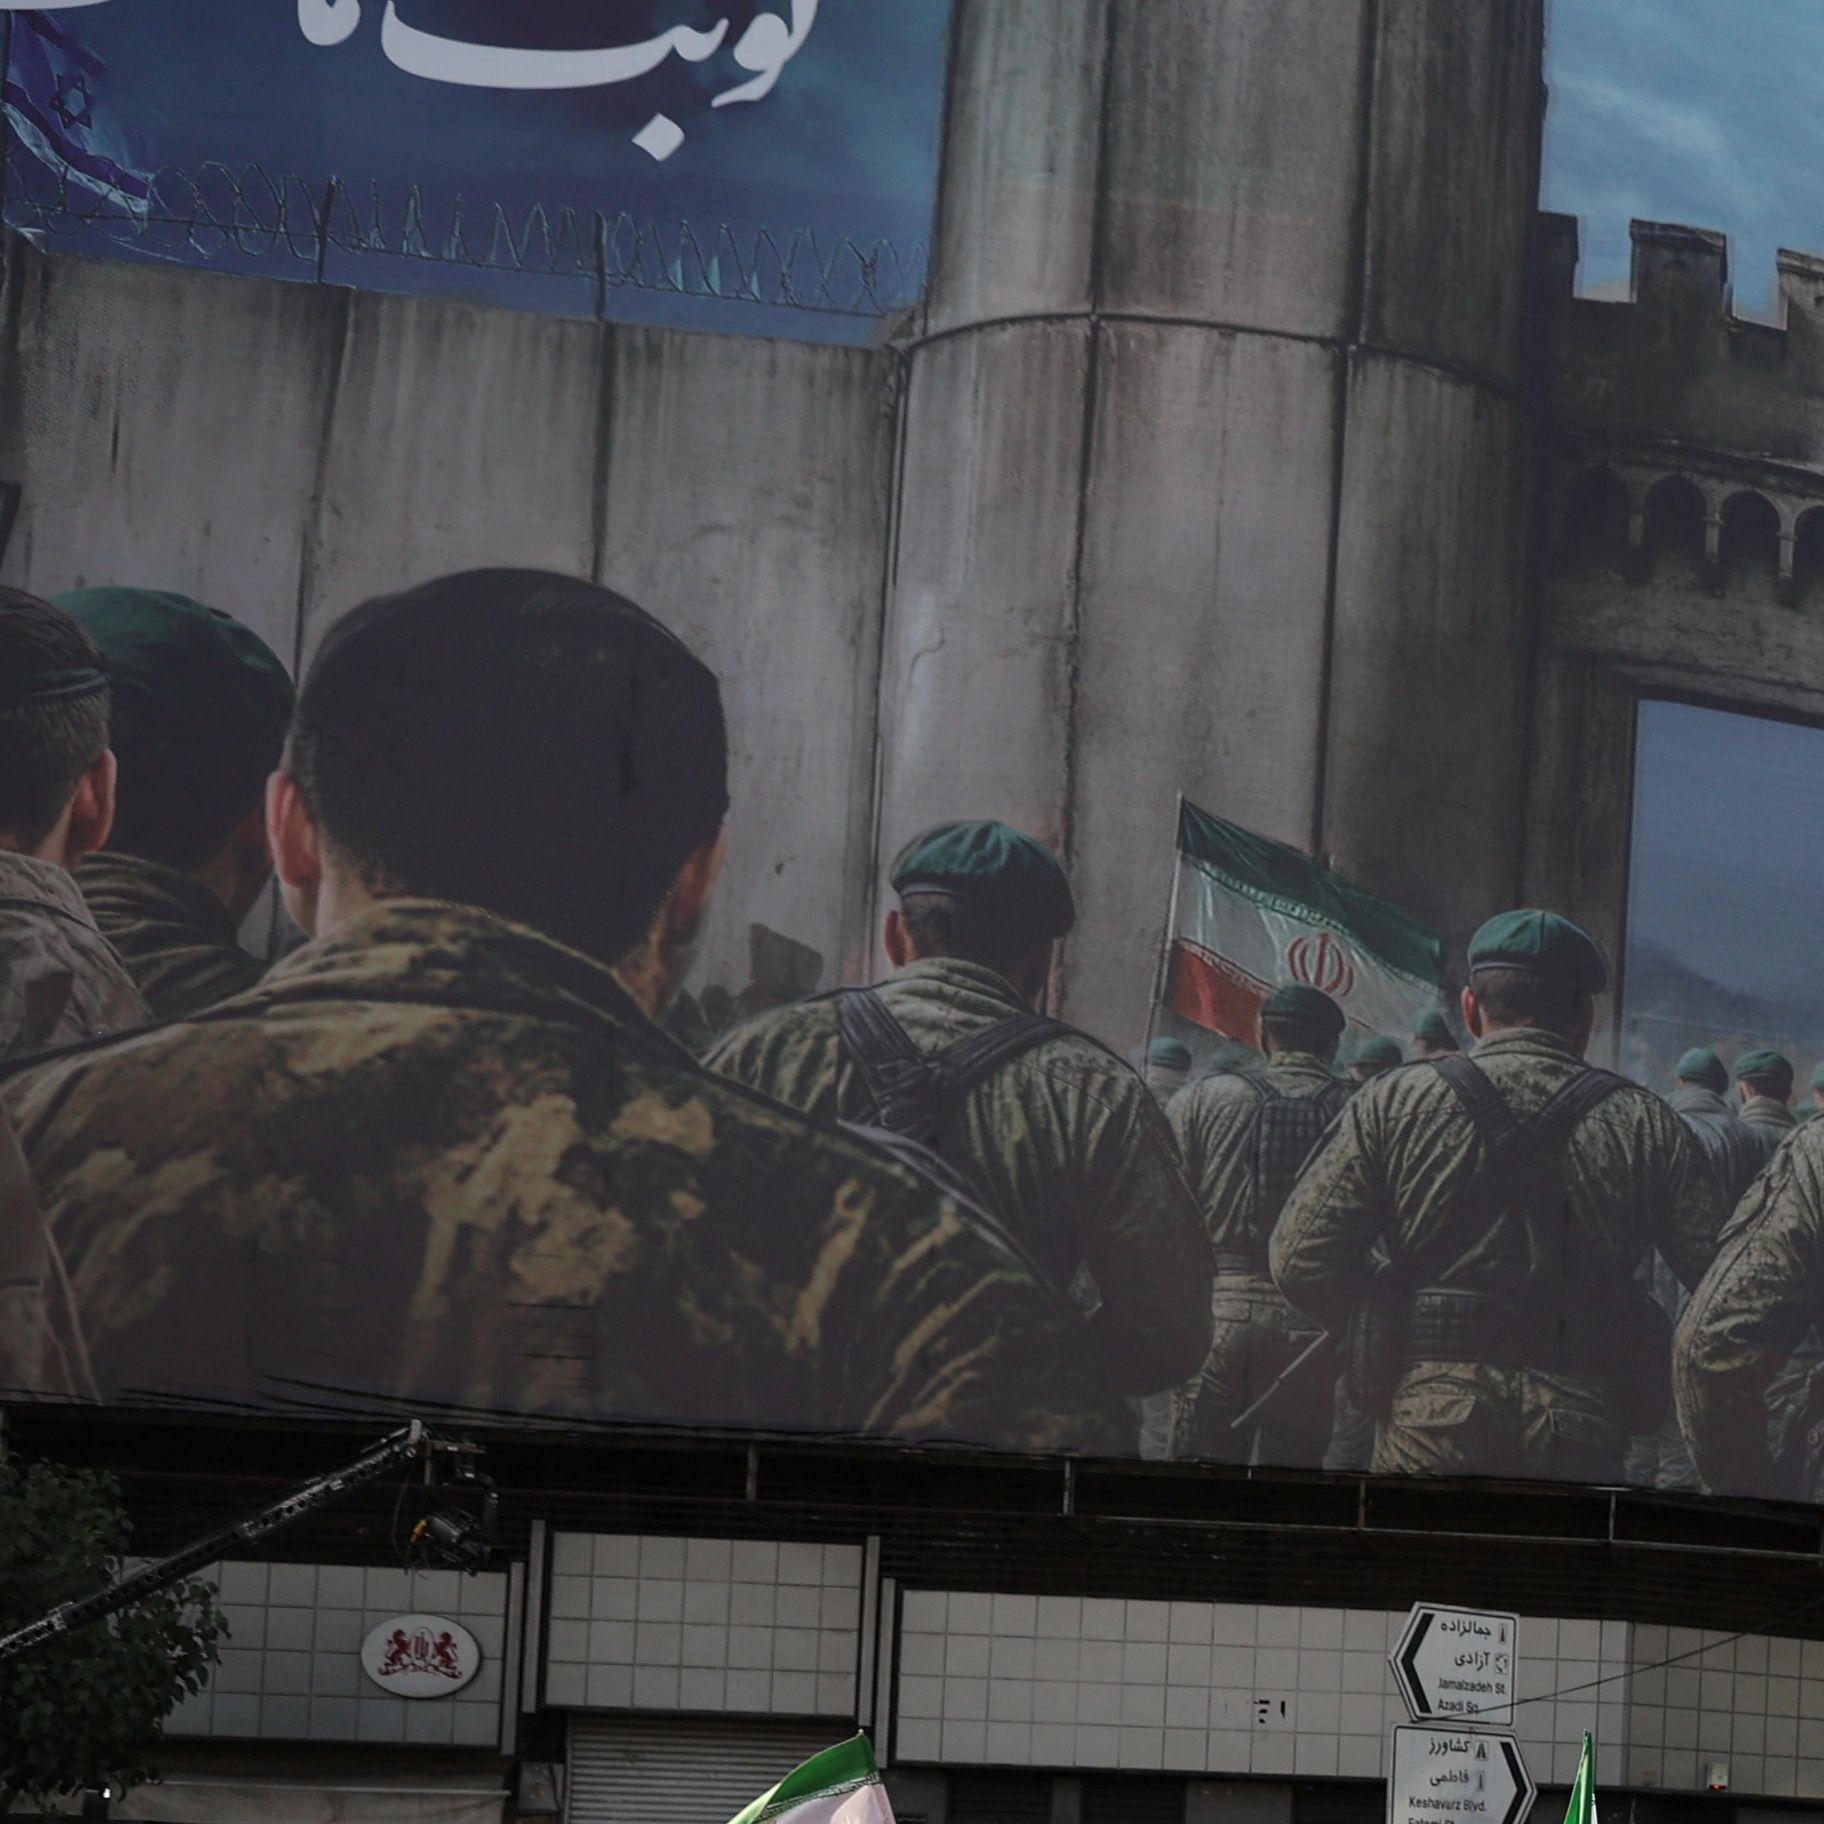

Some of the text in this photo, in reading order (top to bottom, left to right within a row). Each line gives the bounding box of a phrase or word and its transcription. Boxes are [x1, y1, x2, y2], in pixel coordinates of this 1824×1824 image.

[1440, 1619, 1492, 1641] جمالزاده
[1454, 1651, 1490, 1673] آزادی
[1437, 1677, 1507, 1695] Jamalzadeh St.
[1437, 1699, 1464, 1711] Azadi
[1428, 1737, 1471, 1756] کشاورز
[1429, 1769, 1470, 1788] فاطمی
[1408, 1796, 1487, 1813] Keshavarz Blvd.
